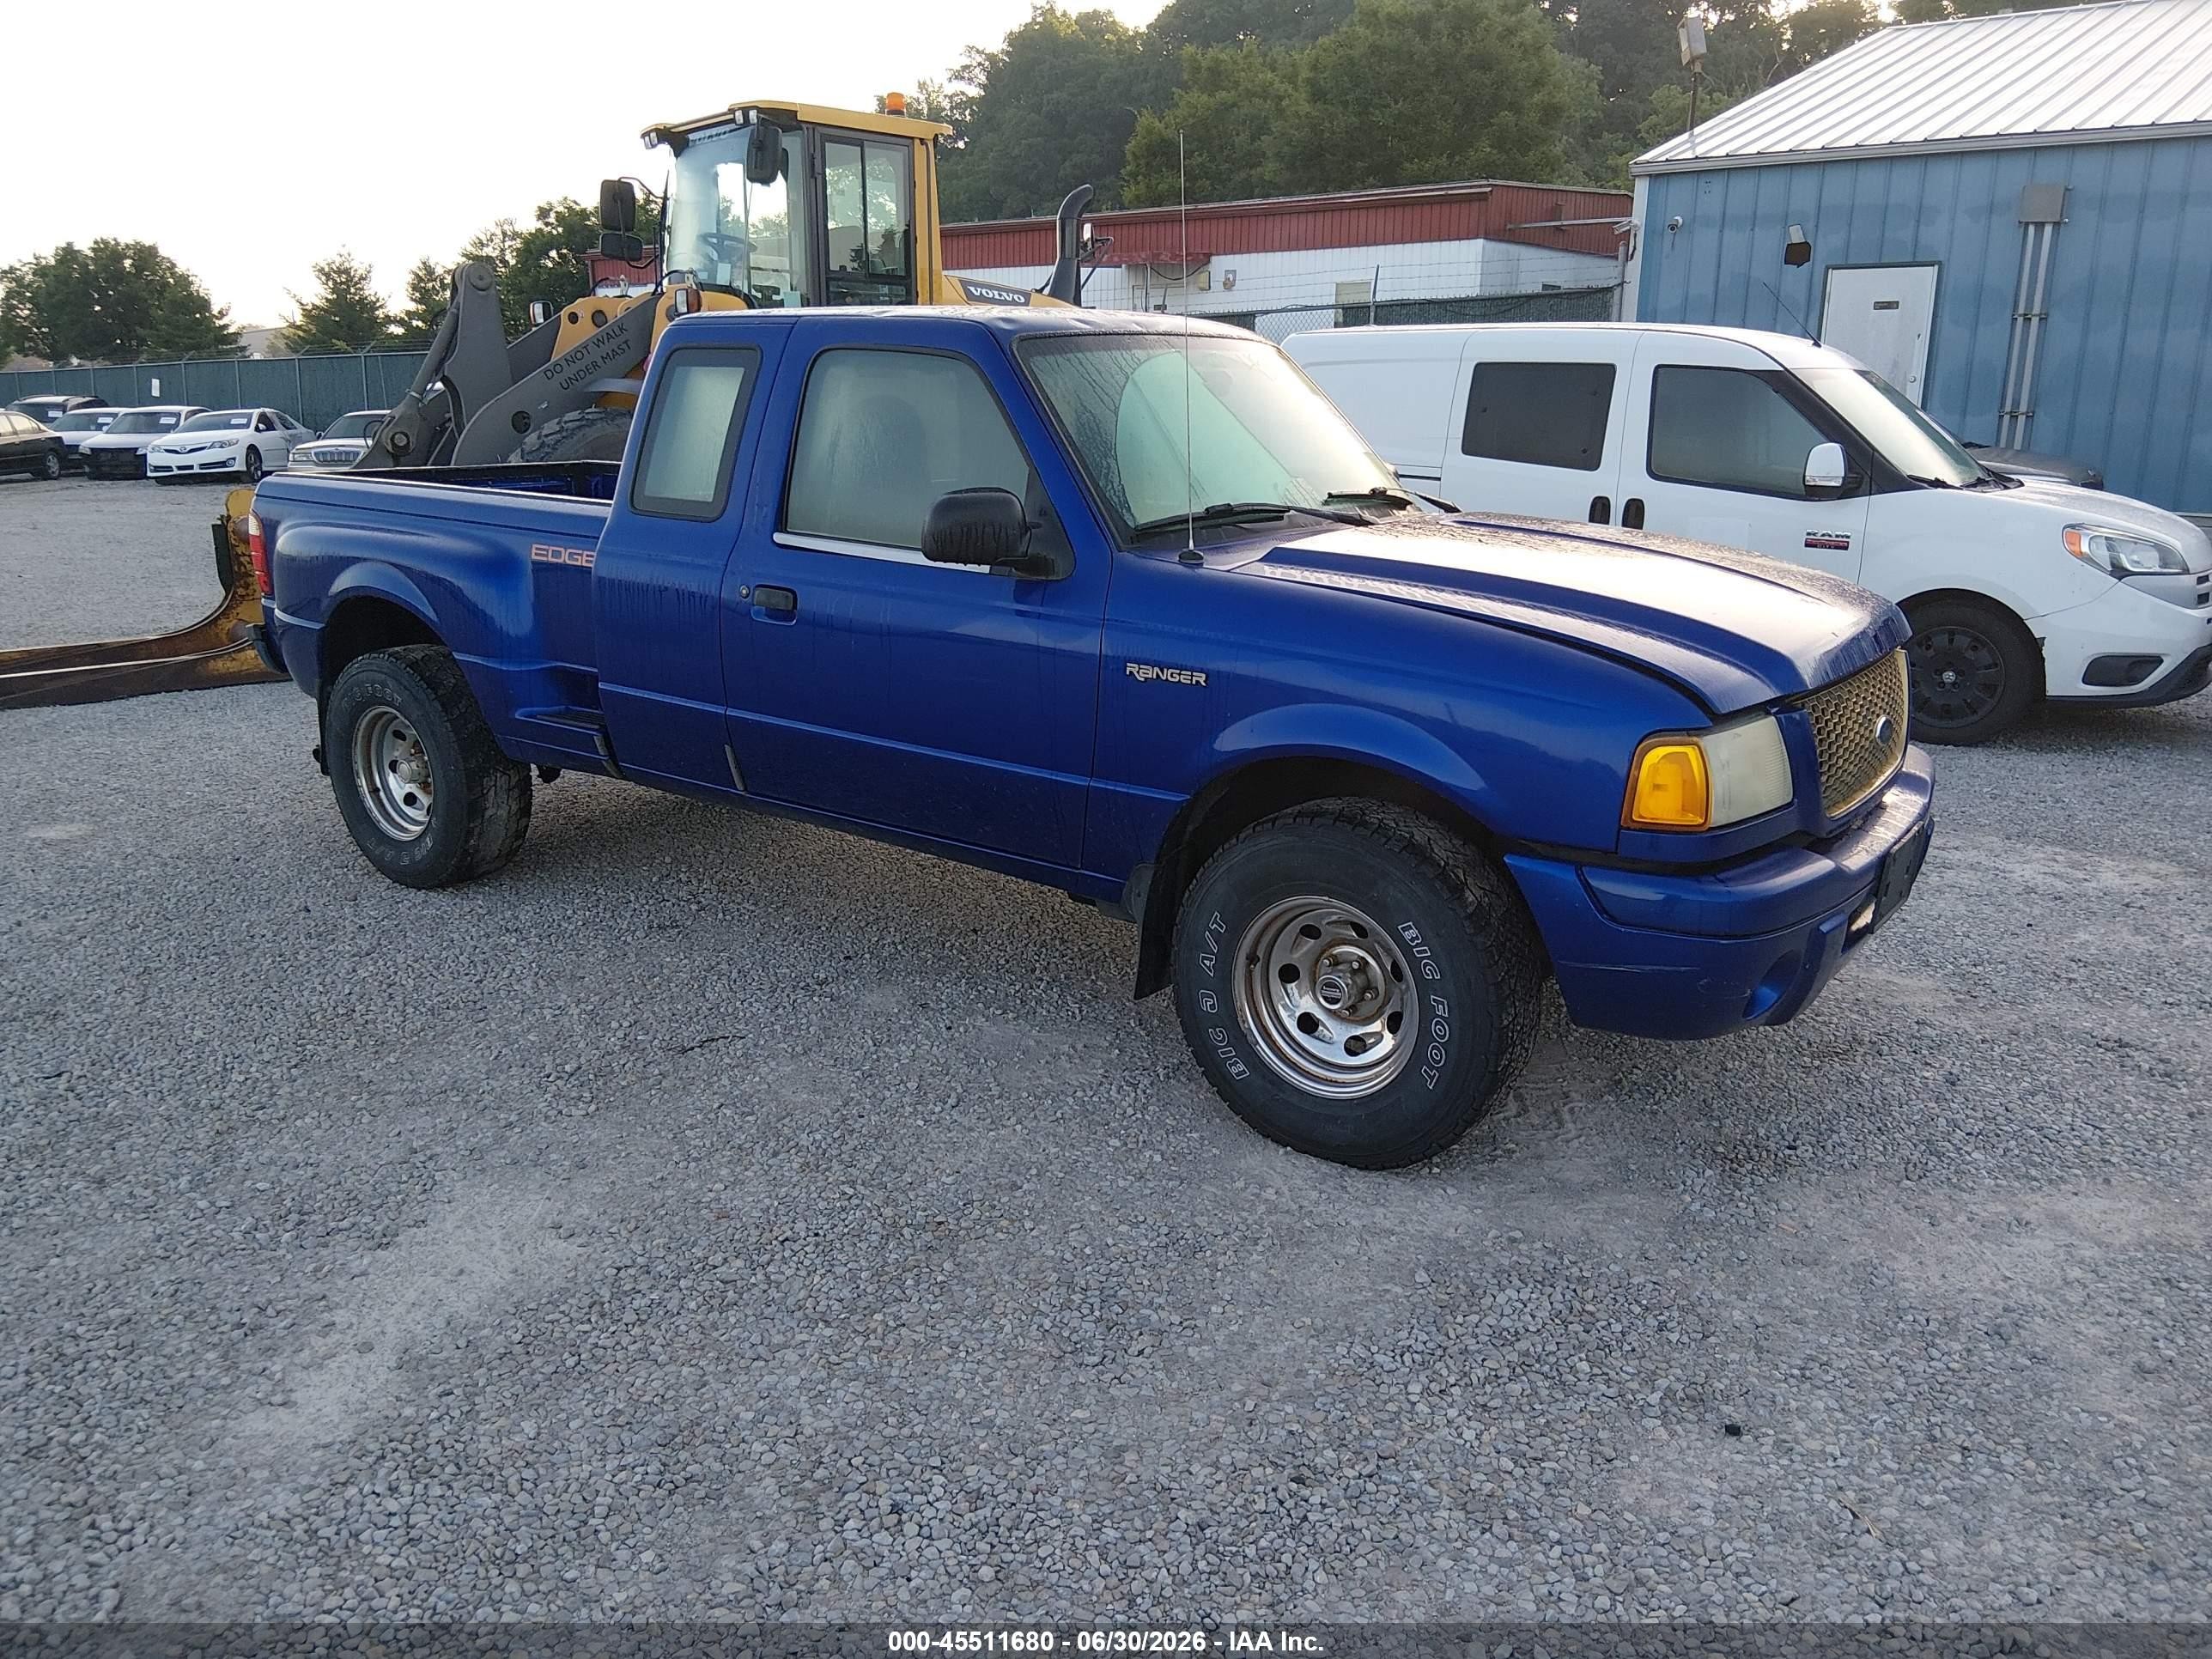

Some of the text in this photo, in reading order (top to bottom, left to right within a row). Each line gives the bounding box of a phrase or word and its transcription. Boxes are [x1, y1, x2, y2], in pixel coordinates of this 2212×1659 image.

[967, 285, 1025, 303] VOLVO
[544, 322, 628, 380] DO NOT WALK
[559, 339, 632, 390] UNDER MAST
[532, 544, 596, 567] EDGE
[1806, 529, 1851, 538] RAM
[1126, 662, 1206, 686] RANGER
[1200, 911, 1226, 977] A/T
[1397, 921, 1449, 1090] BIG FOOT
[1209, 1027, 1249, 1080] BIG
